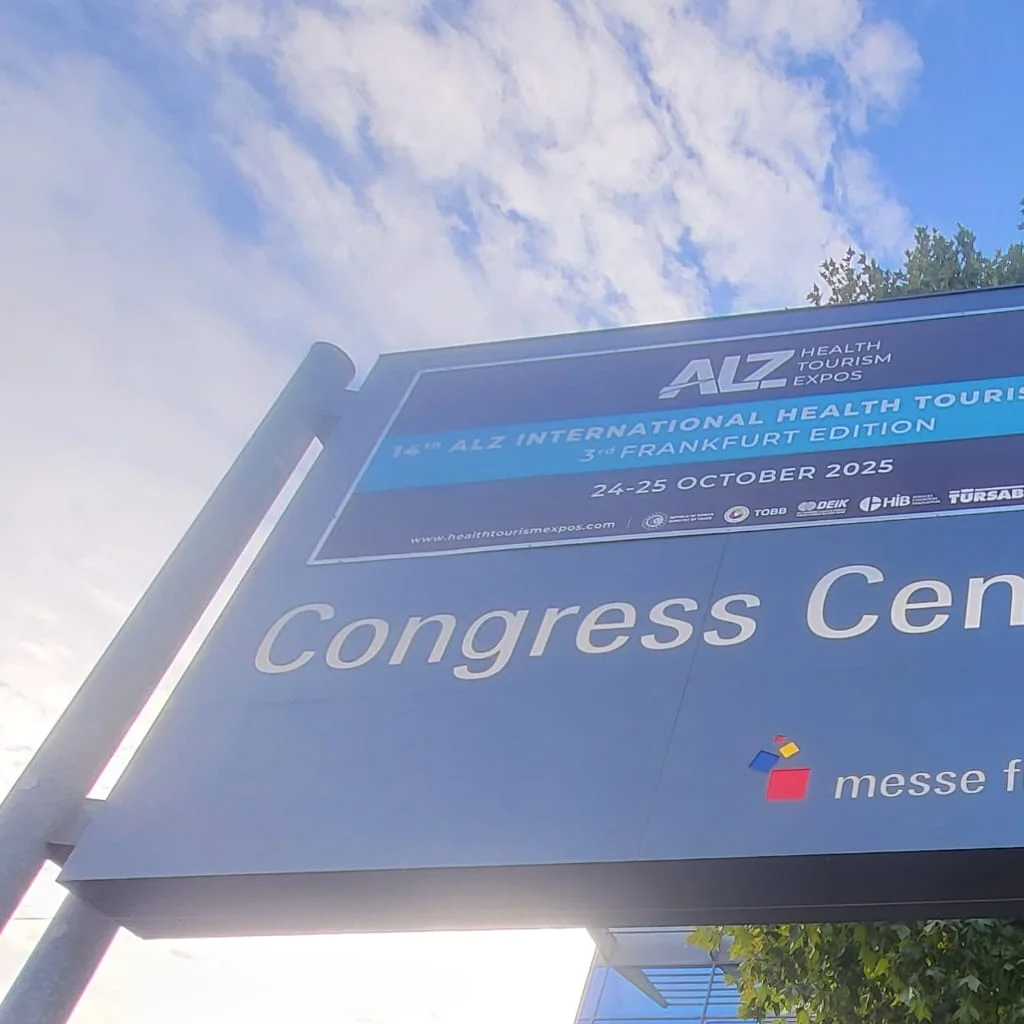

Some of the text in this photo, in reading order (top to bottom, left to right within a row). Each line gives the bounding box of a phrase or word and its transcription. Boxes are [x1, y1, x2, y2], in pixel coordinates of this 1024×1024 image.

[797, 353, 892, 371] TOURISM
[801, 340, 881, 357] HEALTH
[658, 349, 795, 399] ALZ
[793, 370, 863, 386] EXPOS
[448, 436, 505, 452] ALZ
[516, 412, 763, 447] INTERNATIONAL
[777, 398, 900, 423] HEALTH
[579, 417, 936, 462] 3rd FRANKFURT EDITION
[590, 459, 894, 498] 24-25 OCTOBER 2025
[754, 507, 787, 517] TOBB
[410, 520, 616, 544] www.healthtourismexpos.com
[254, 594, 760, 680] Congress
[833, 771, 986, 799] messe
